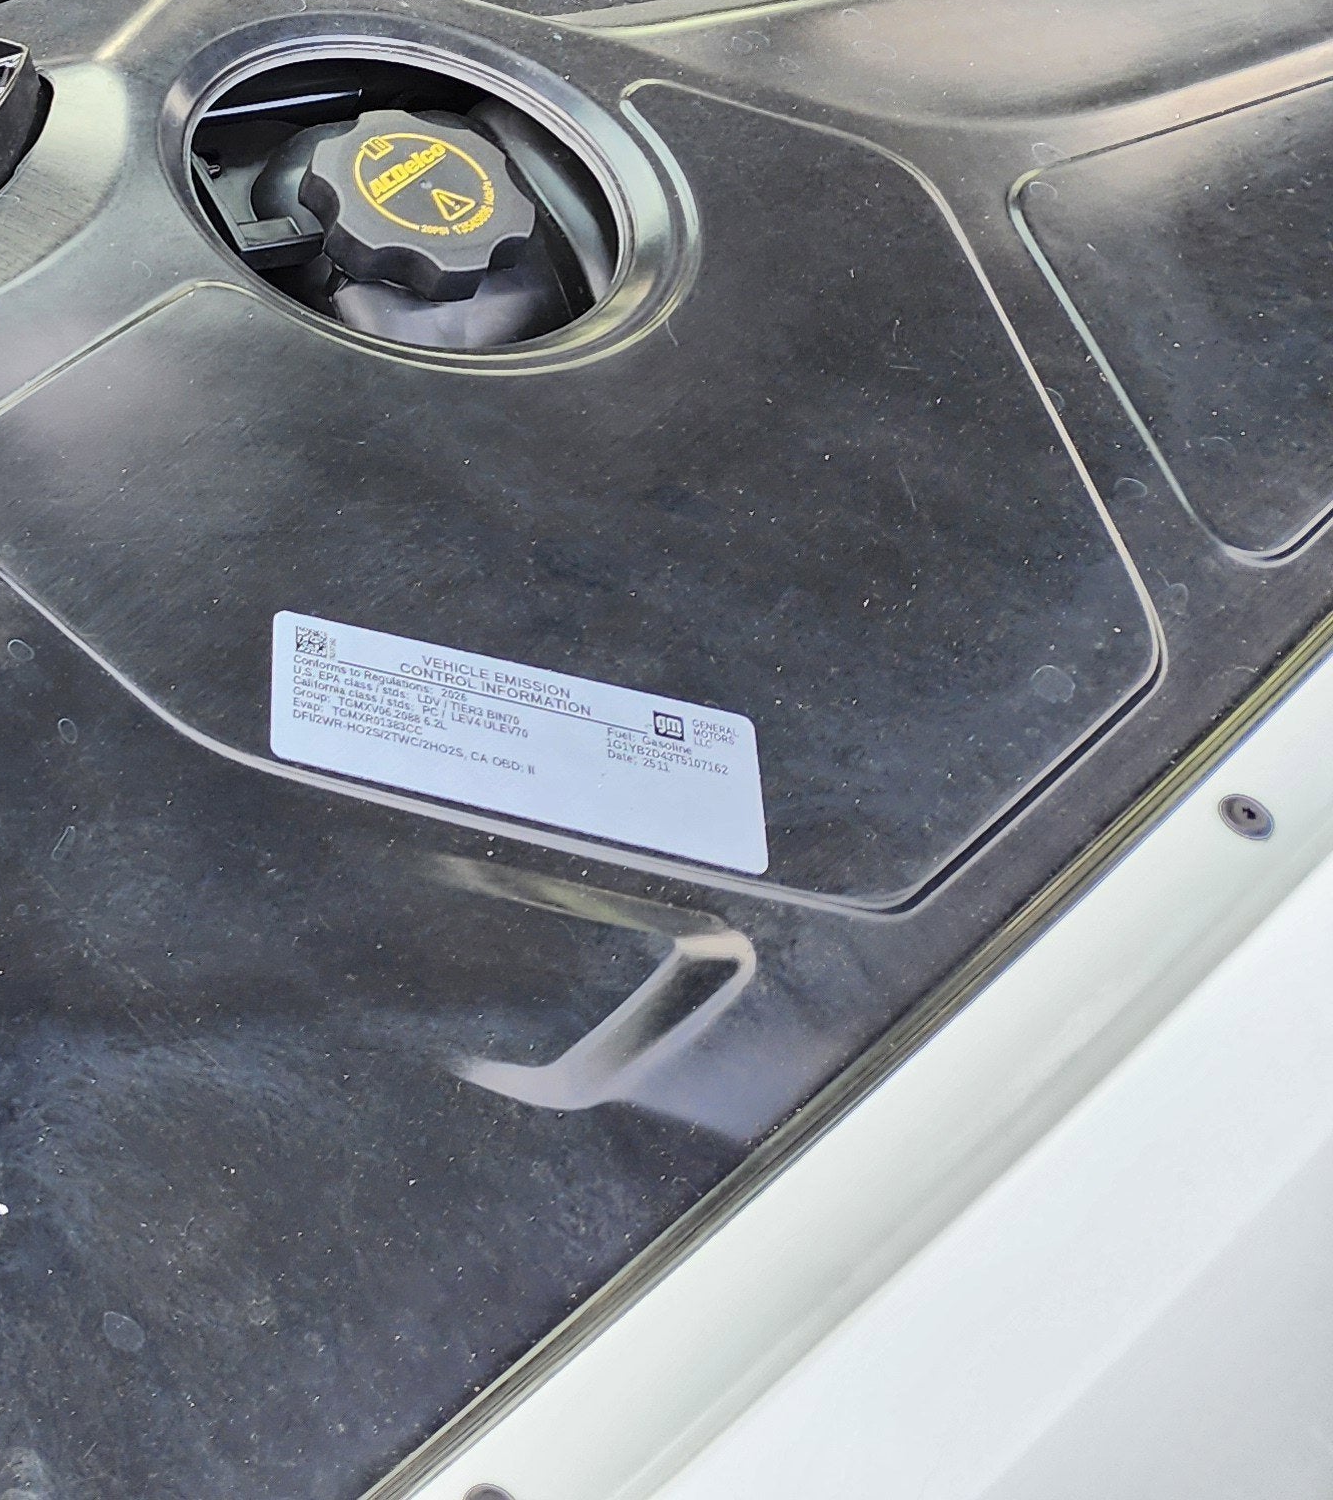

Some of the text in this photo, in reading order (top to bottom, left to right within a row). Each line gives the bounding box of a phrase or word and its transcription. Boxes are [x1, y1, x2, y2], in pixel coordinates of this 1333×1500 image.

[369, 143, 446, 198] ACDelco
[293, 654, 346, 674] Conforms
[350, 667, 361, 677] to
[364, 670, 433, 696] Regulations:
[422, 655, 571, 699] VEHICLE EMISSION
[293, 686, 330, 703] Group:
[318, 670, 339, 683] EPA
[344, 676, 373, 691] class
[417, 693, 439, 706] LDV
[451, 701, 482, 716] TIER3
[487, 709, 519, 725] BIN70
[400, 662, 591, 716] CONTROL INFORMATION
[292, 697, 323, 713] Evap:
[293, 675, 345, 695] California
[348, 688, 377, 702] class
[422, 705, 438, 716] PC
[451, 712, 480, 727] LEV4
[483, 719, 528, 738] ULEV70
[607, 726, 692, 754] Fuel: Gasoline
[692, 719, 739, 738] GENERAL
[693, 729, 735, 746] MOTORS
[607, 749, 637, 764] Date:
[694, 740, 712, 749] LLC
[471, 751, 487, 763] CA
[492, 756, 524, 772] OBD:
